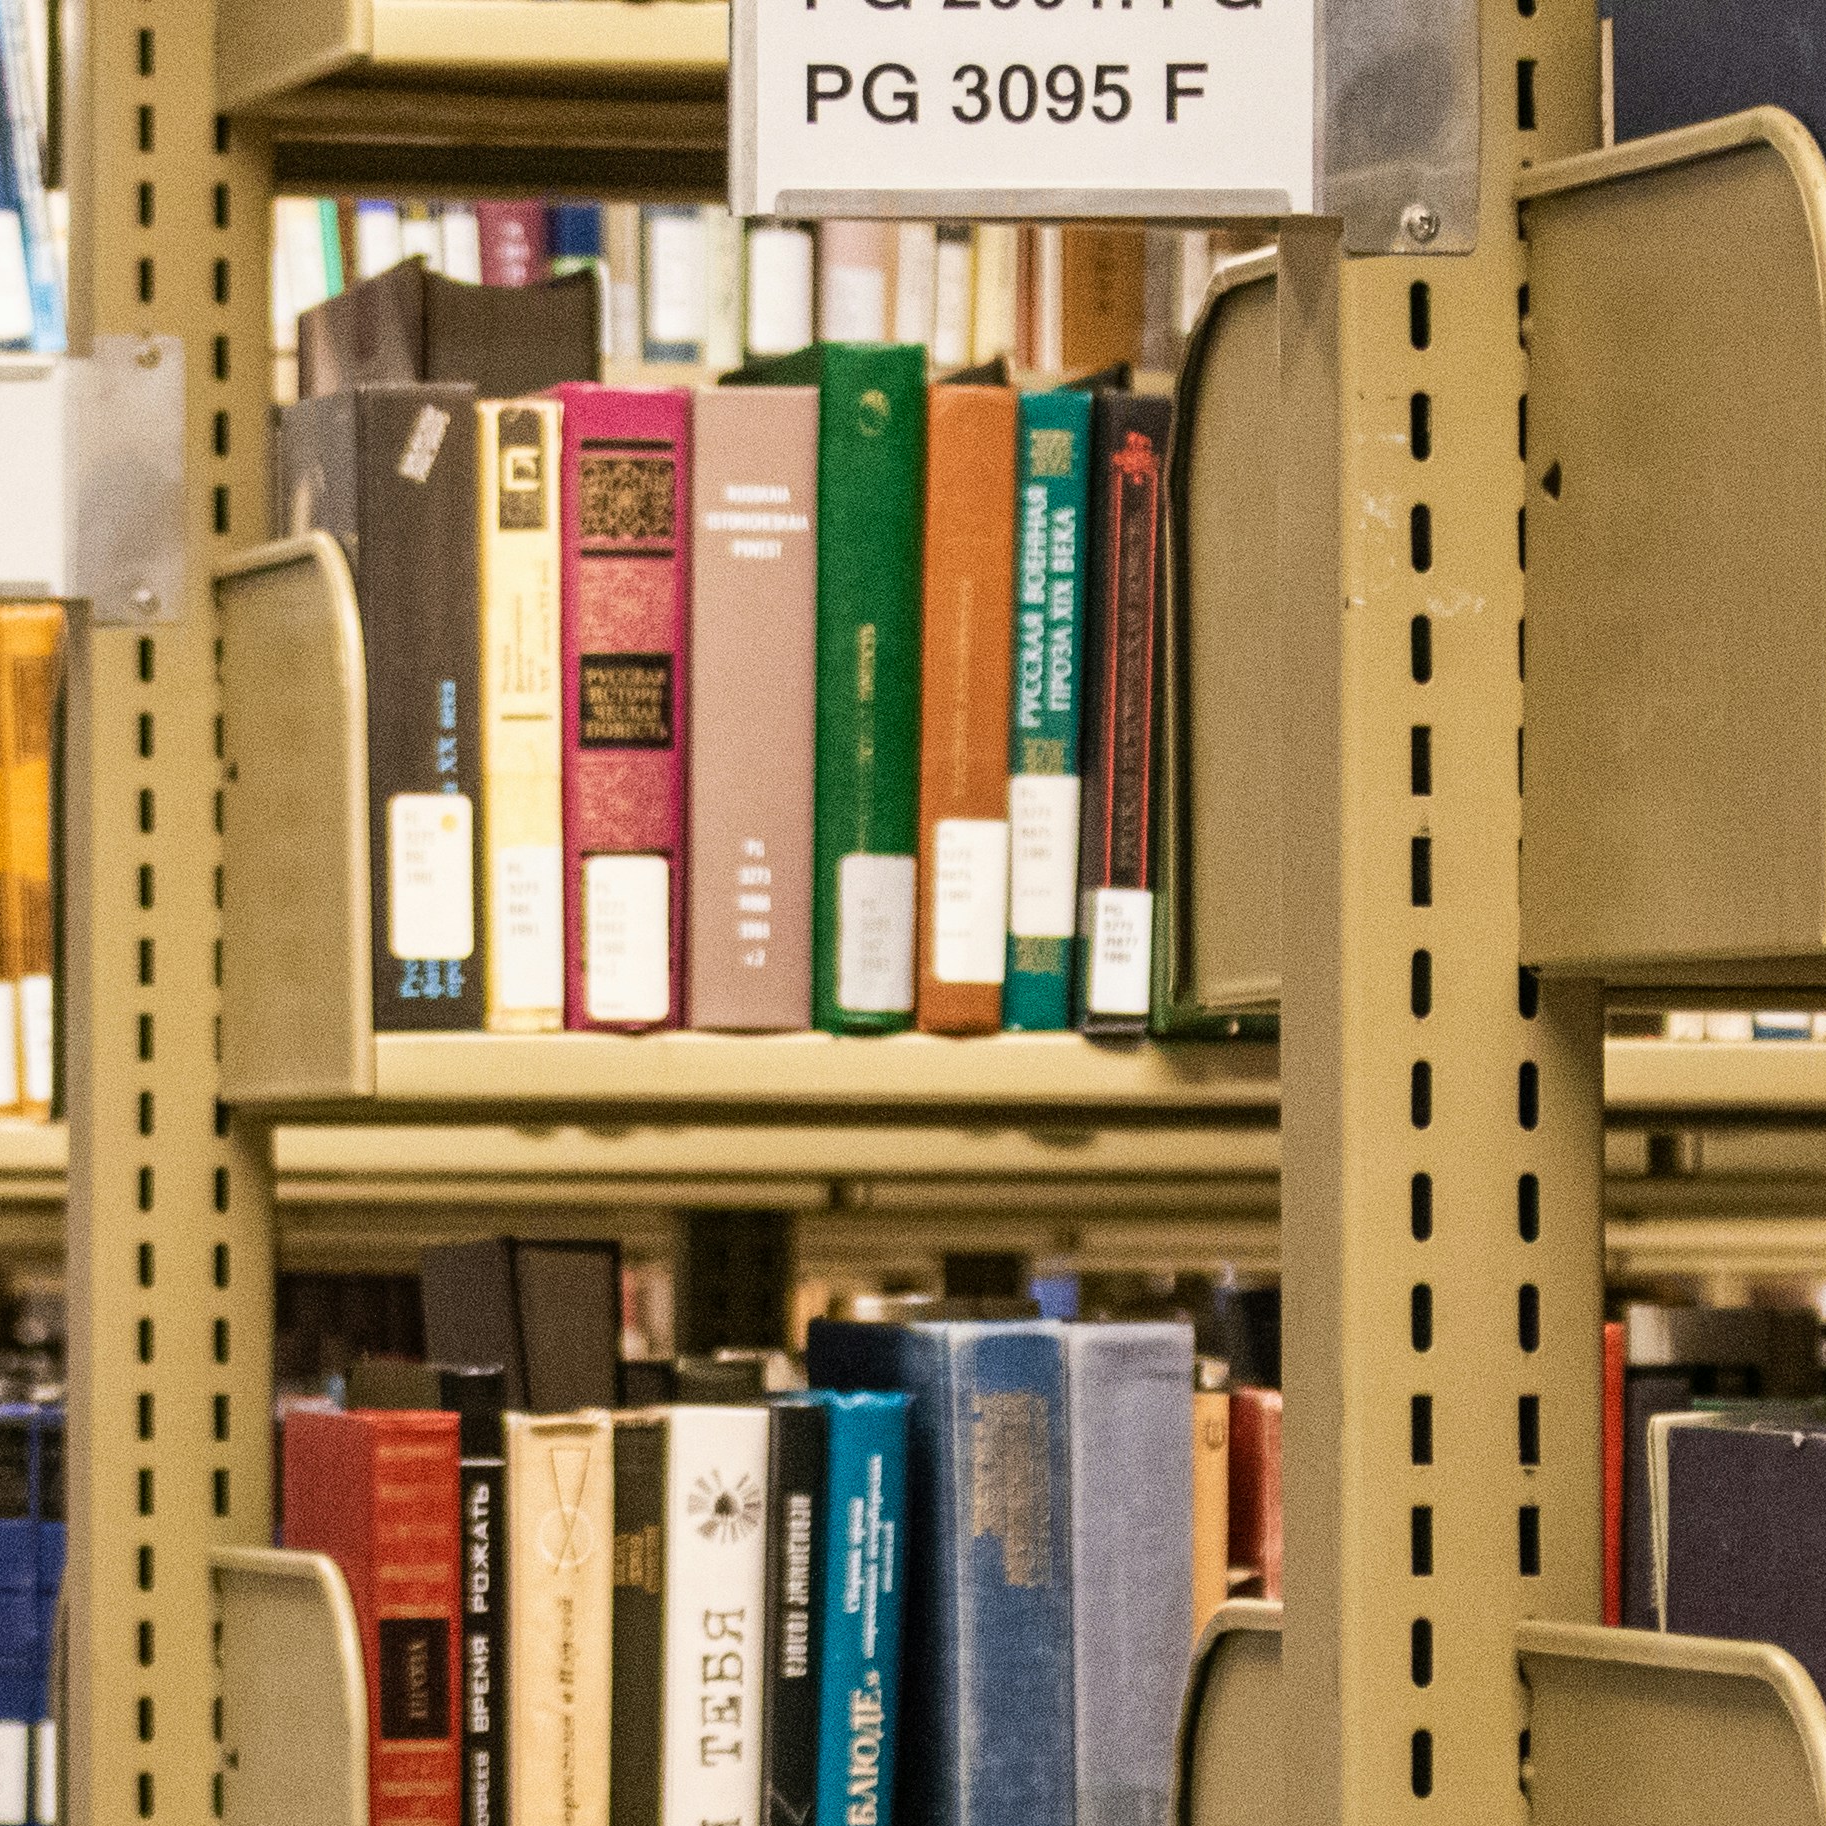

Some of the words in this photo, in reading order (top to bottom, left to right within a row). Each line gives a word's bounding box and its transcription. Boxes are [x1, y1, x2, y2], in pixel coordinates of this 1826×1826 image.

[806, 62, 919, 124] PG
[951, 63, 1132, 124] 3095
[1166, 62, 1209, 124] F
[699, 1607, 746, 1769] ТЕБЯ
